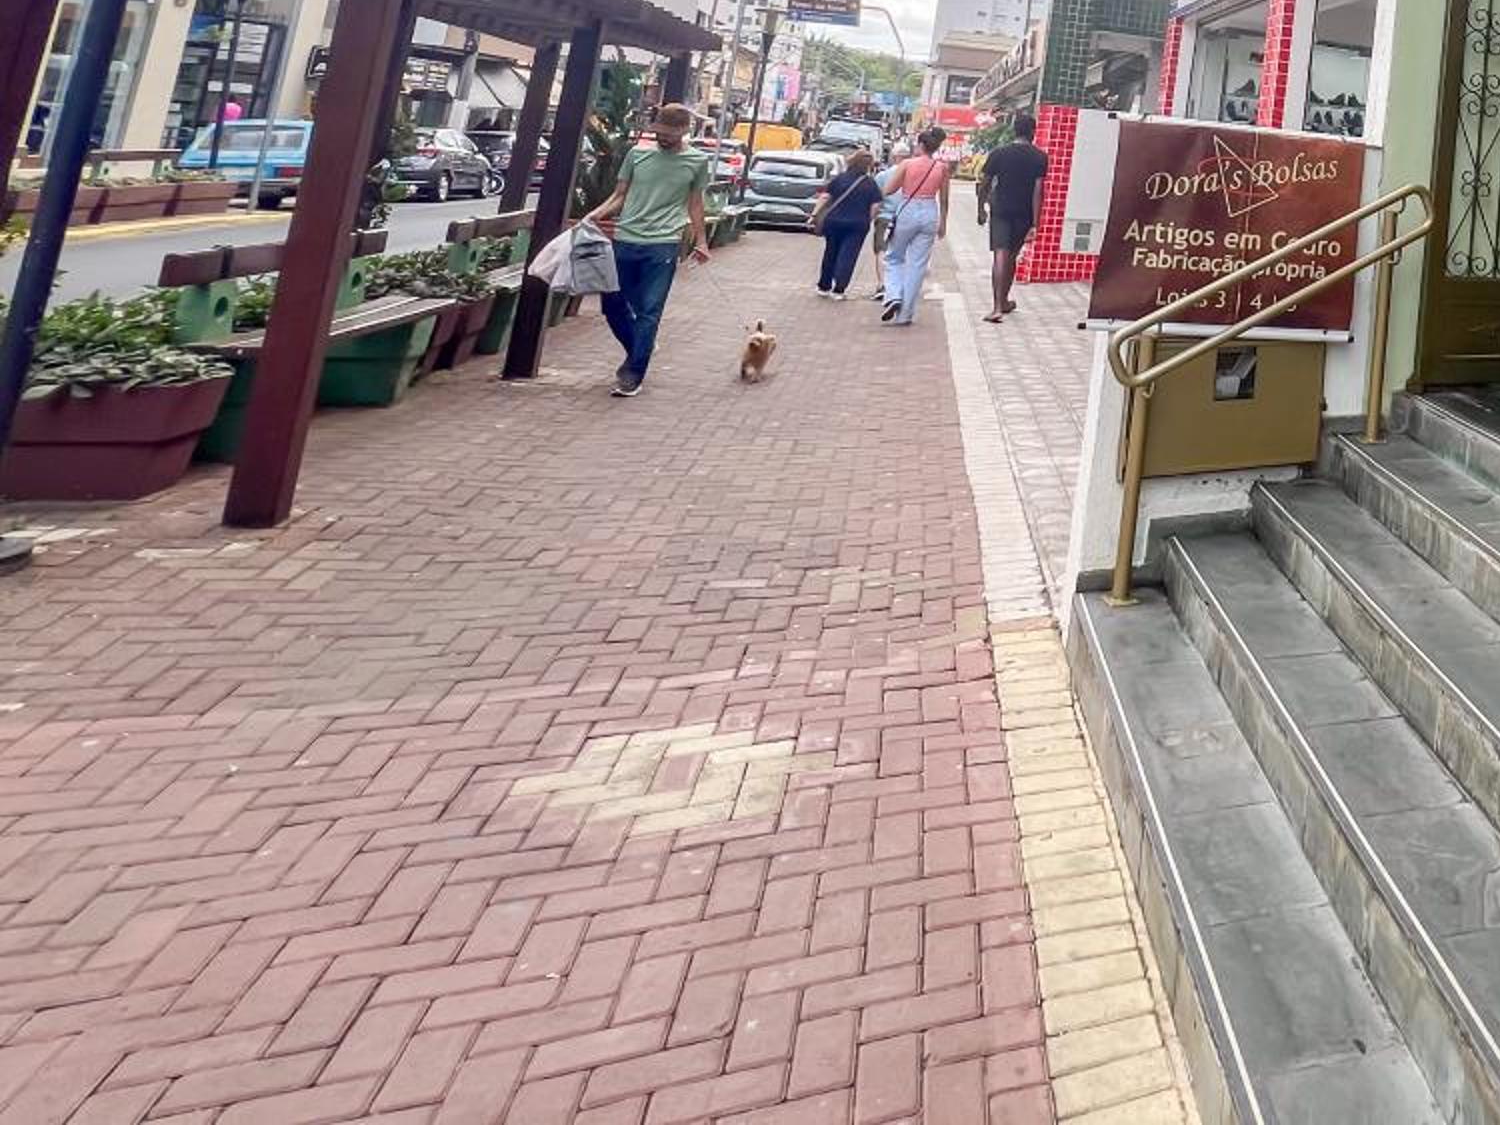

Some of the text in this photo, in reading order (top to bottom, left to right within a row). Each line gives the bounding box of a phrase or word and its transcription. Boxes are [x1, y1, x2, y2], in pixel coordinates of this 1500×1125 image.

[1145, 152, 1339, 200] Dora's Bolsas
[1123, 218, 1216, 250] Artigos
[1223, 231, 1261, 251] em
[1132, 247, 1248, 278] Fabricação
[1155, 286, 1209, 309] Los
[1215, 289, 1227, 308] 3
[1249, 292, 1263, 310] 4
